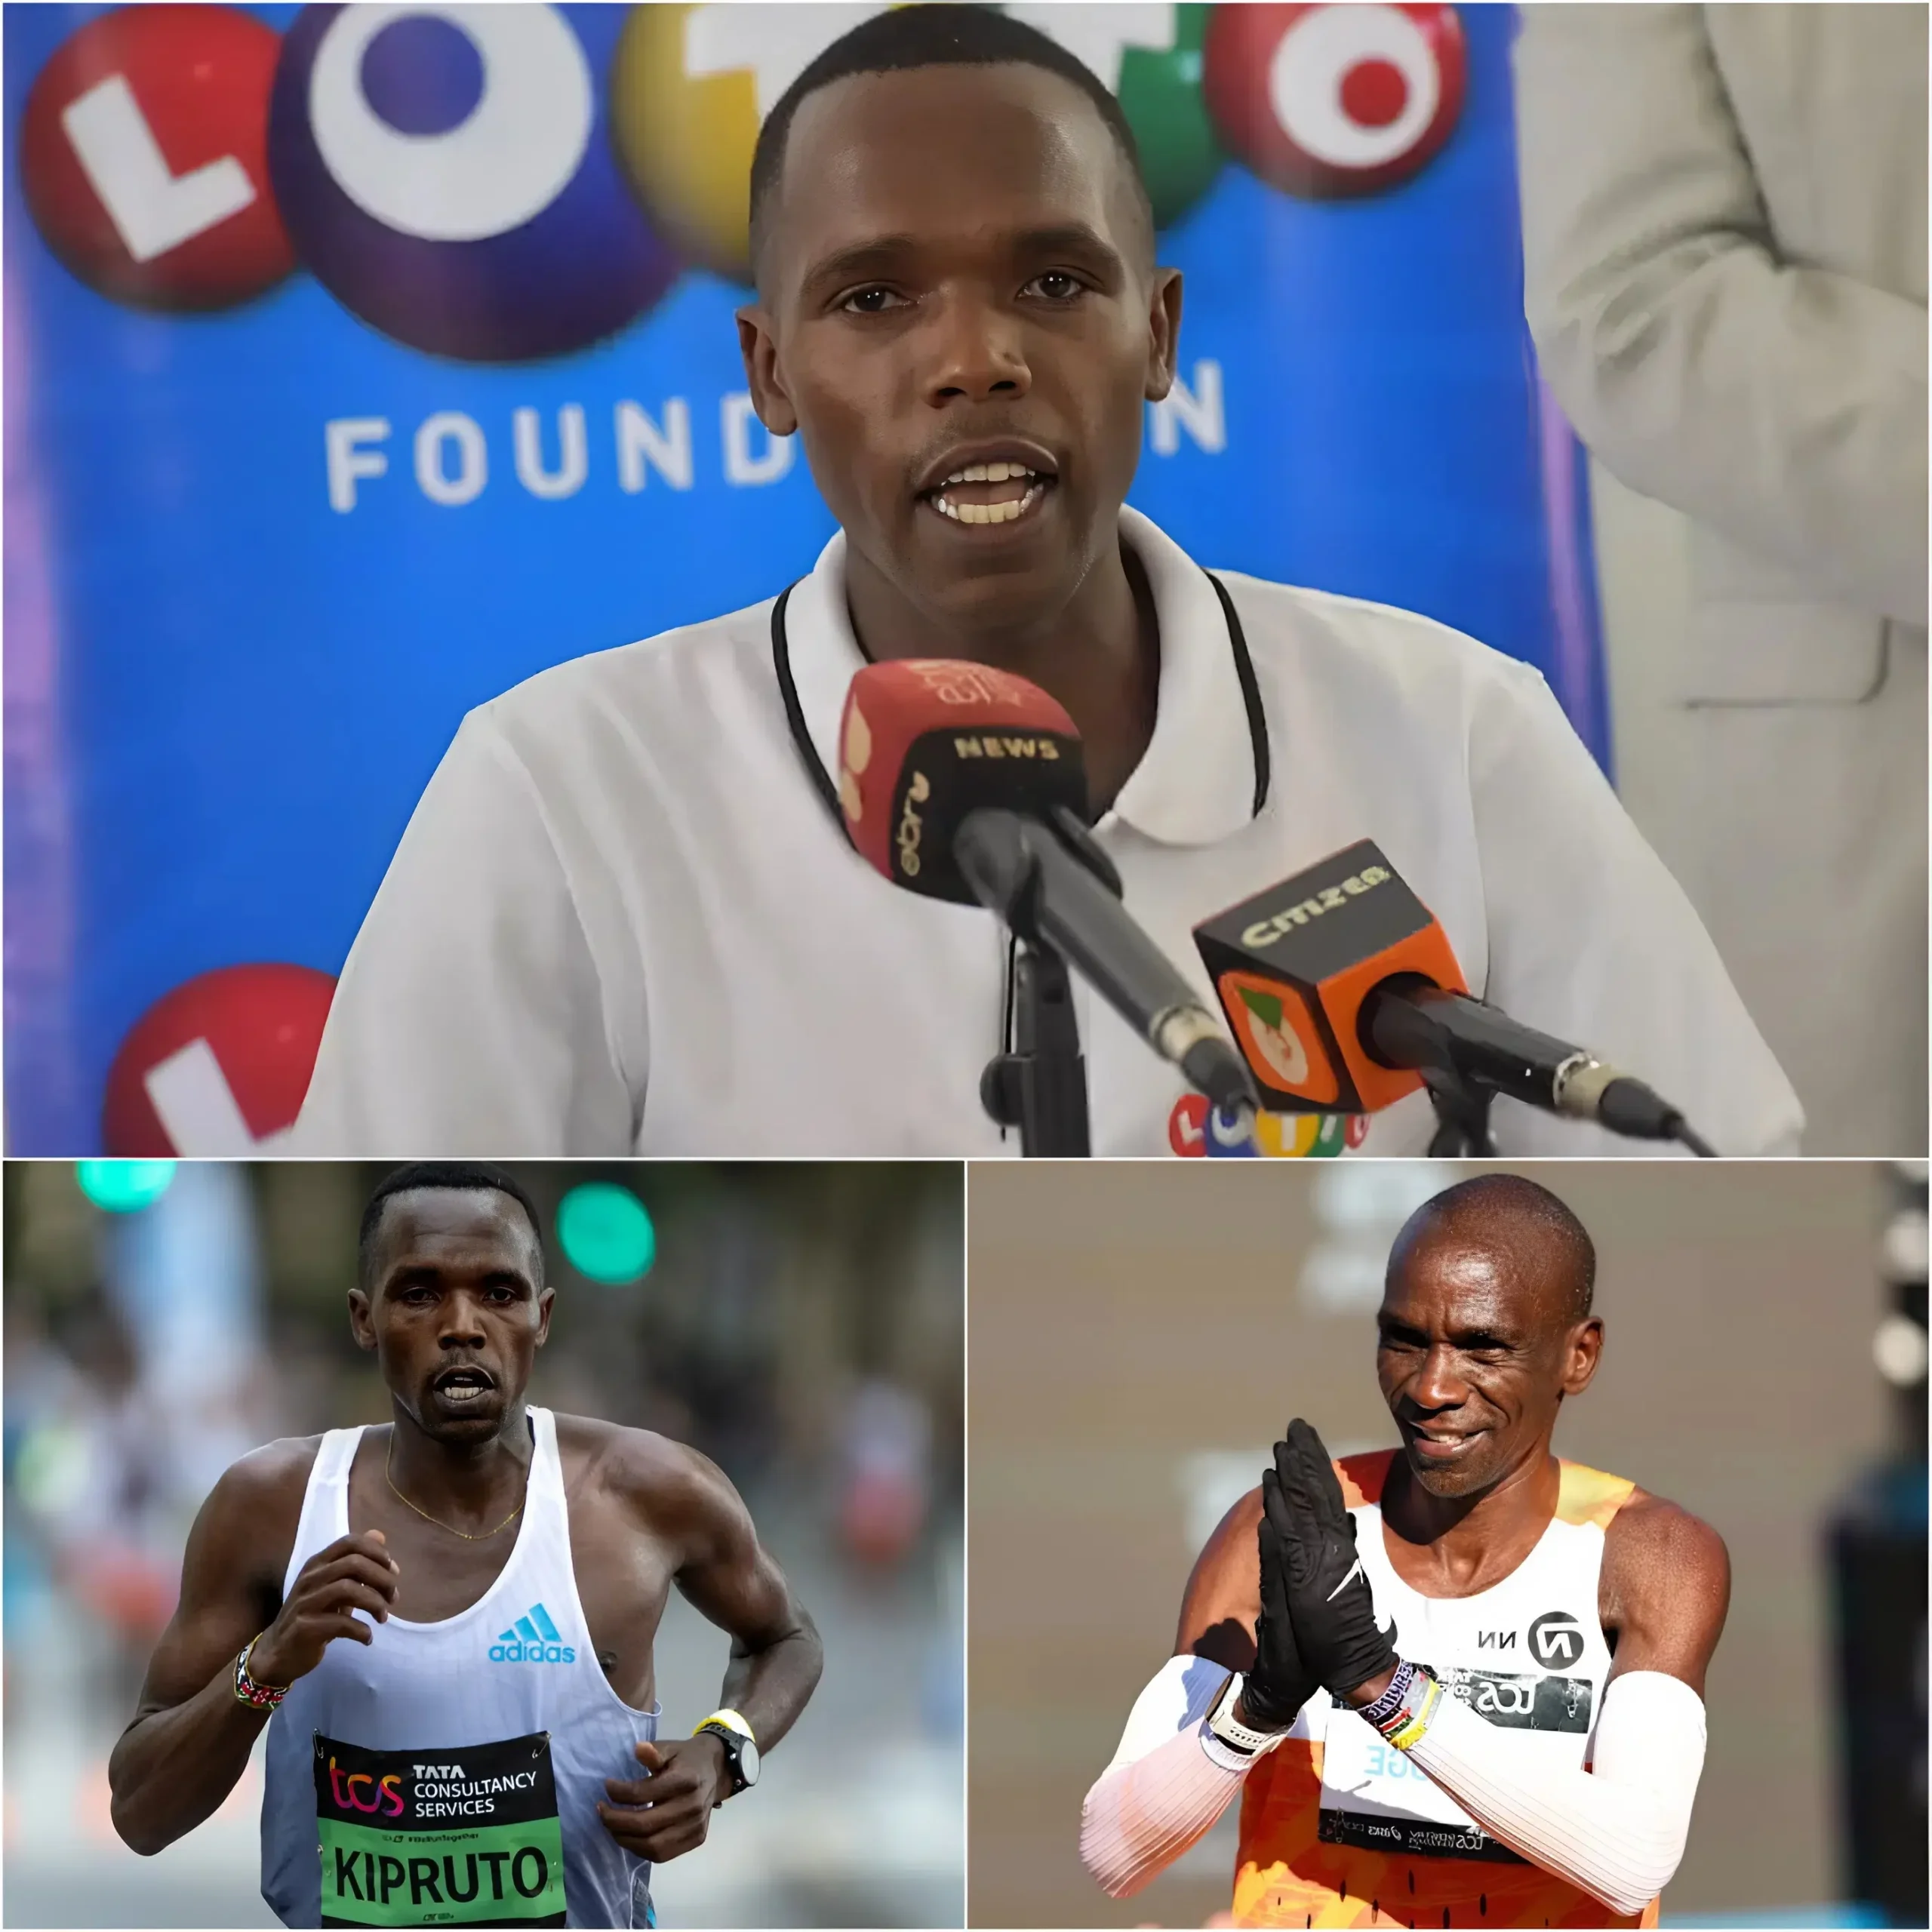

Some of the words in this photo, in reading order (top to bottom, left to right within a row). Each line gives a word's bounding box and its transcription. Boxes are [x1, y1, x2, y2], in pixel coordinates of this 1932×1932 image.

[325, 360, 1229, 514] FOUNDN
[954, 735, 1060, 759] NEWS
[488, 1640, 576, 1663] adidas
[413, 1764, 466, 1780] TATA
[414, 1771, 537, 1798] CONSULTANCY
[329, 1755, 405, 1817] tcs
[415, 1798, 495, 1818] SERVICES
[334, 1846, 549, 1905] KIPRUTO
